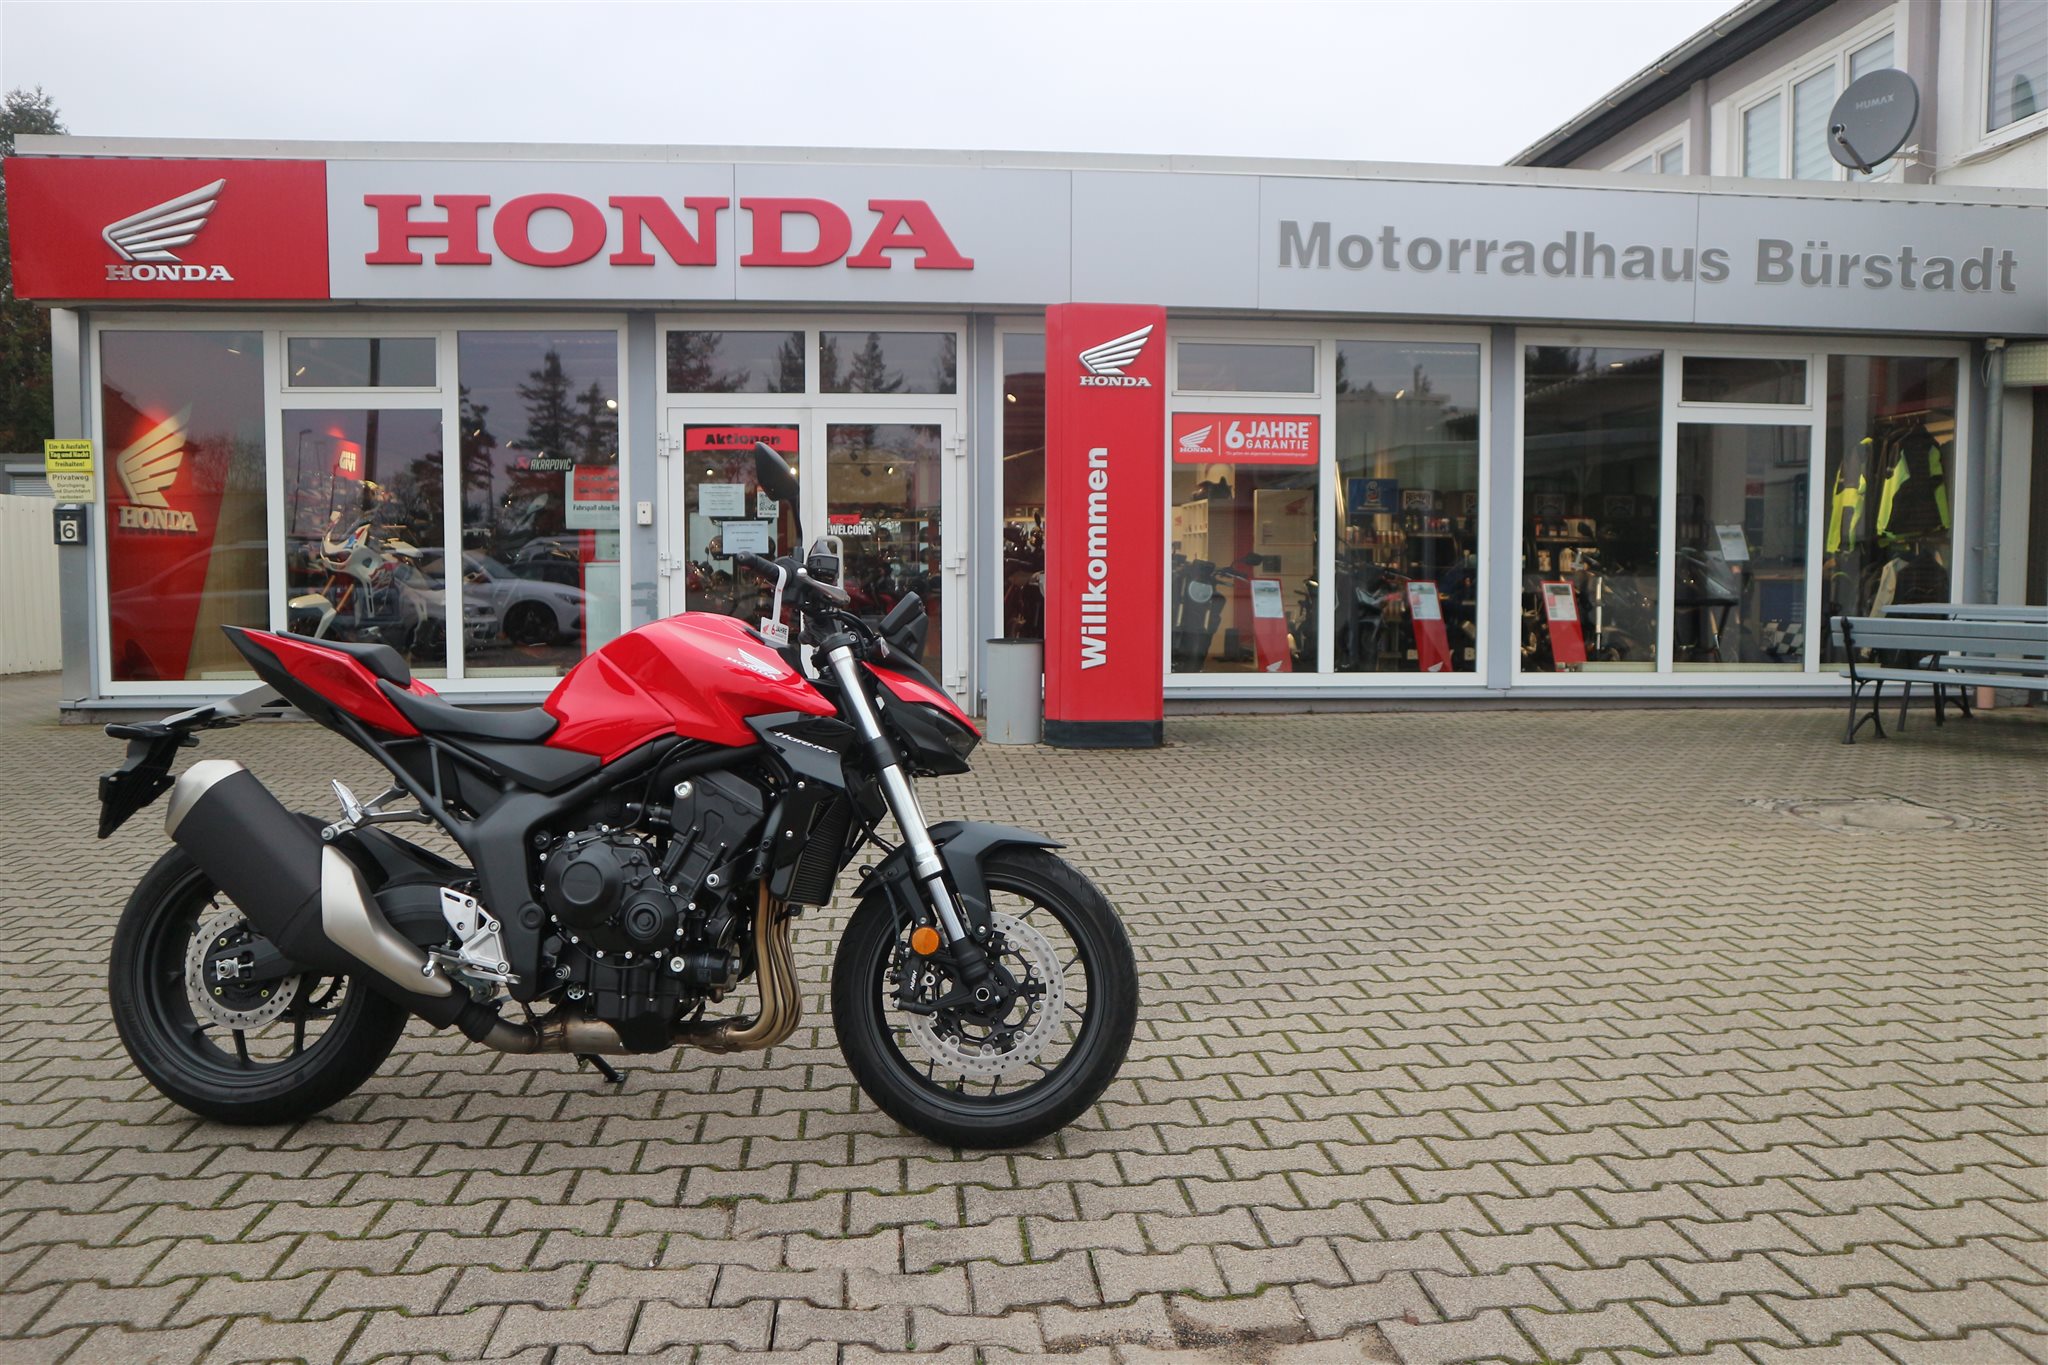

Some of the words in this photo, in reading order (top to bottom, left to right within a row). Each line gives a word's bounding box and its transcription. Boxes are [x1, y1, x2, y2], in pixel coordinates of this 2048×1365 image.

[1856, 94, 1895, 110] HUMAX
[364, 193, 975, 271] HONDA
[1279, 219, 1730, 283] Motorradhaus
[1756, 238, 2018, 292] Bürstadt
[105, 264, 234, 281] HONDA
[1079, 375, 1153, 387] HONDA
[705, 433, 781, 445] Aktionen
[1225, 421, 1245, 449] 6
[1246, 440, 1309, 450] GARANTIE
[119, 506, 198, 532] HONDA
[62, 522, 76, 539] 6
[830, 524, 872, 535] WELCOME
[1081, 447, 1108, 669] Willkommen
